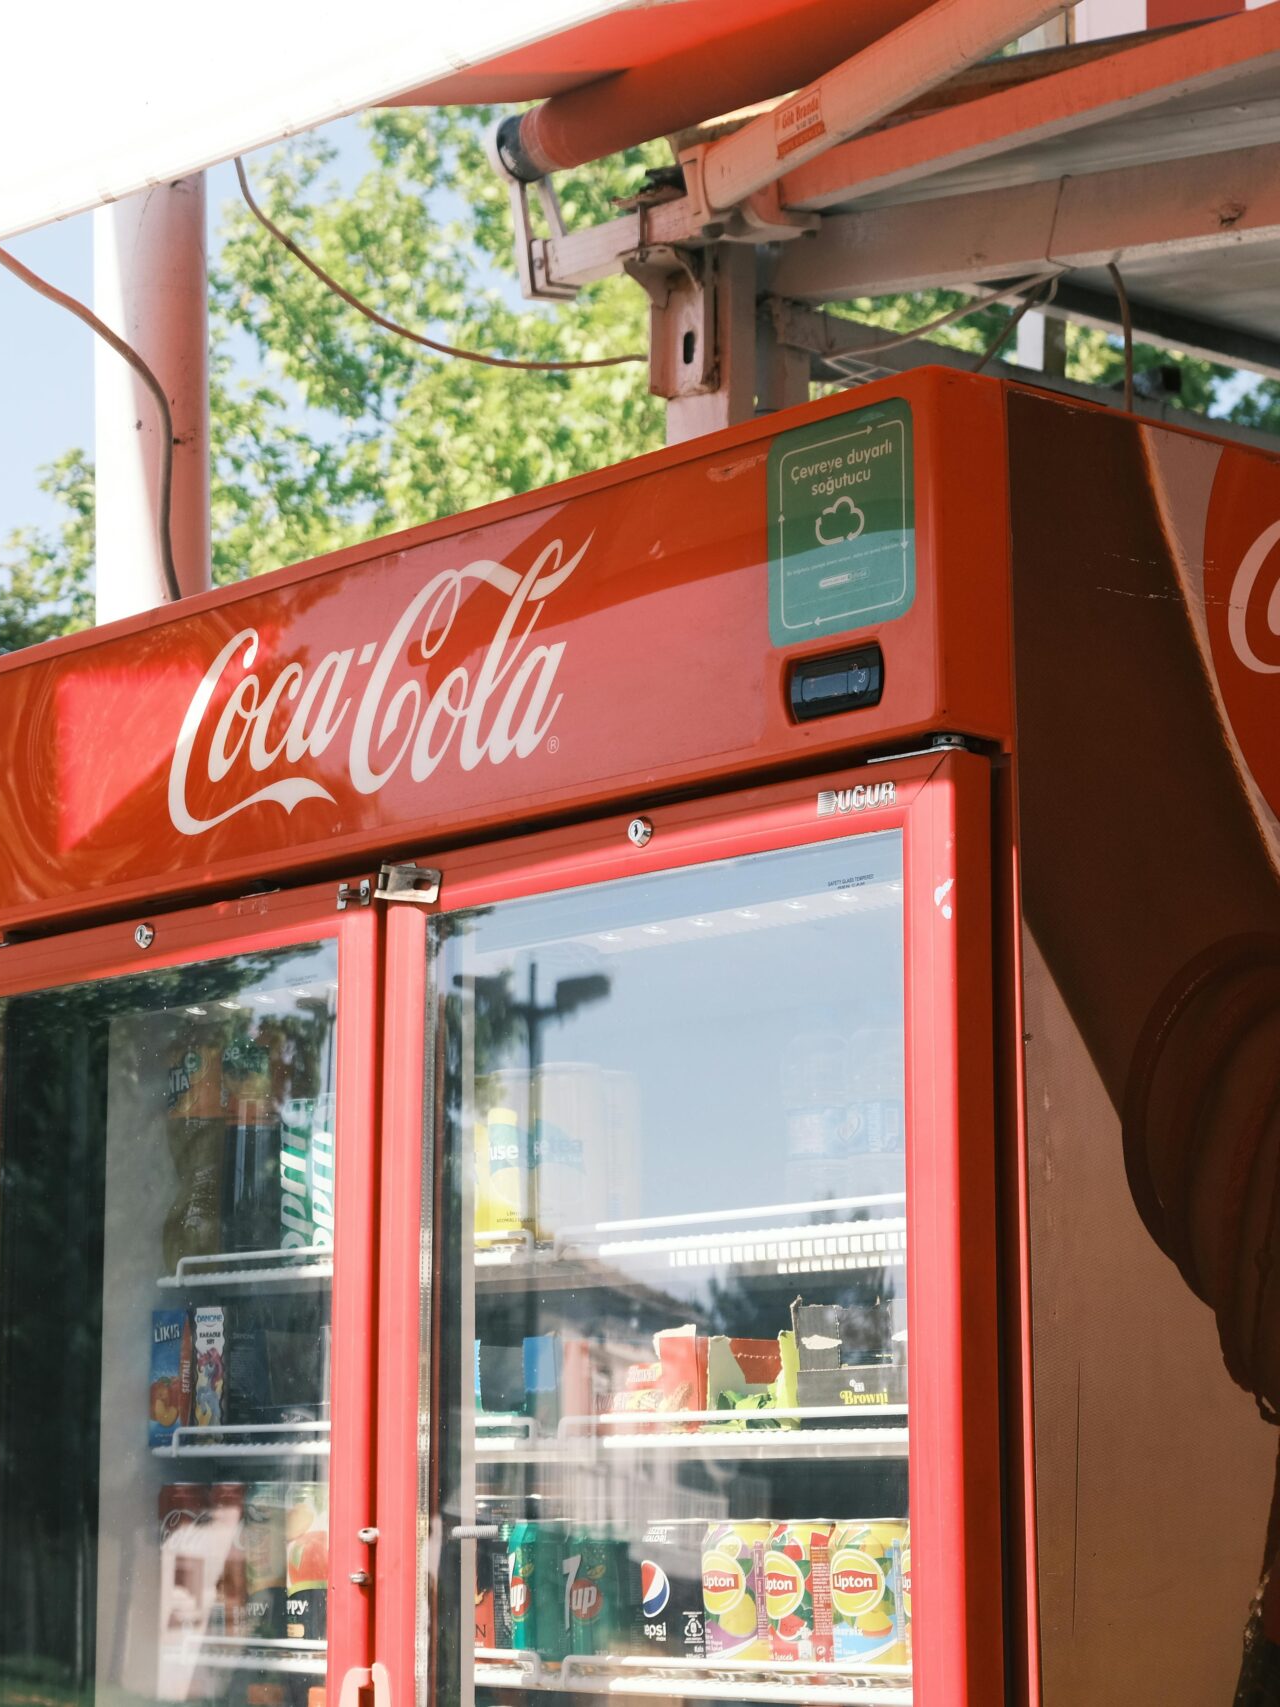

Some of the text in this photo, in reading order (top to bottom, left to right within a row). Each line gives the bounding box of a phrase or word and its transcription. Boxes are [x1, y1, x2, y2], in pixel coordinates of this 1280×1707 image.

[790, 438, 893, 485] Çevreye duyarlı
[811, 468, 871, 496] soğutucu
[168, 527, 596, 836] Coca-Cola
[839, 1388, 889, 1406] Browni
[834, 1574, 873, 1589] Lipton
